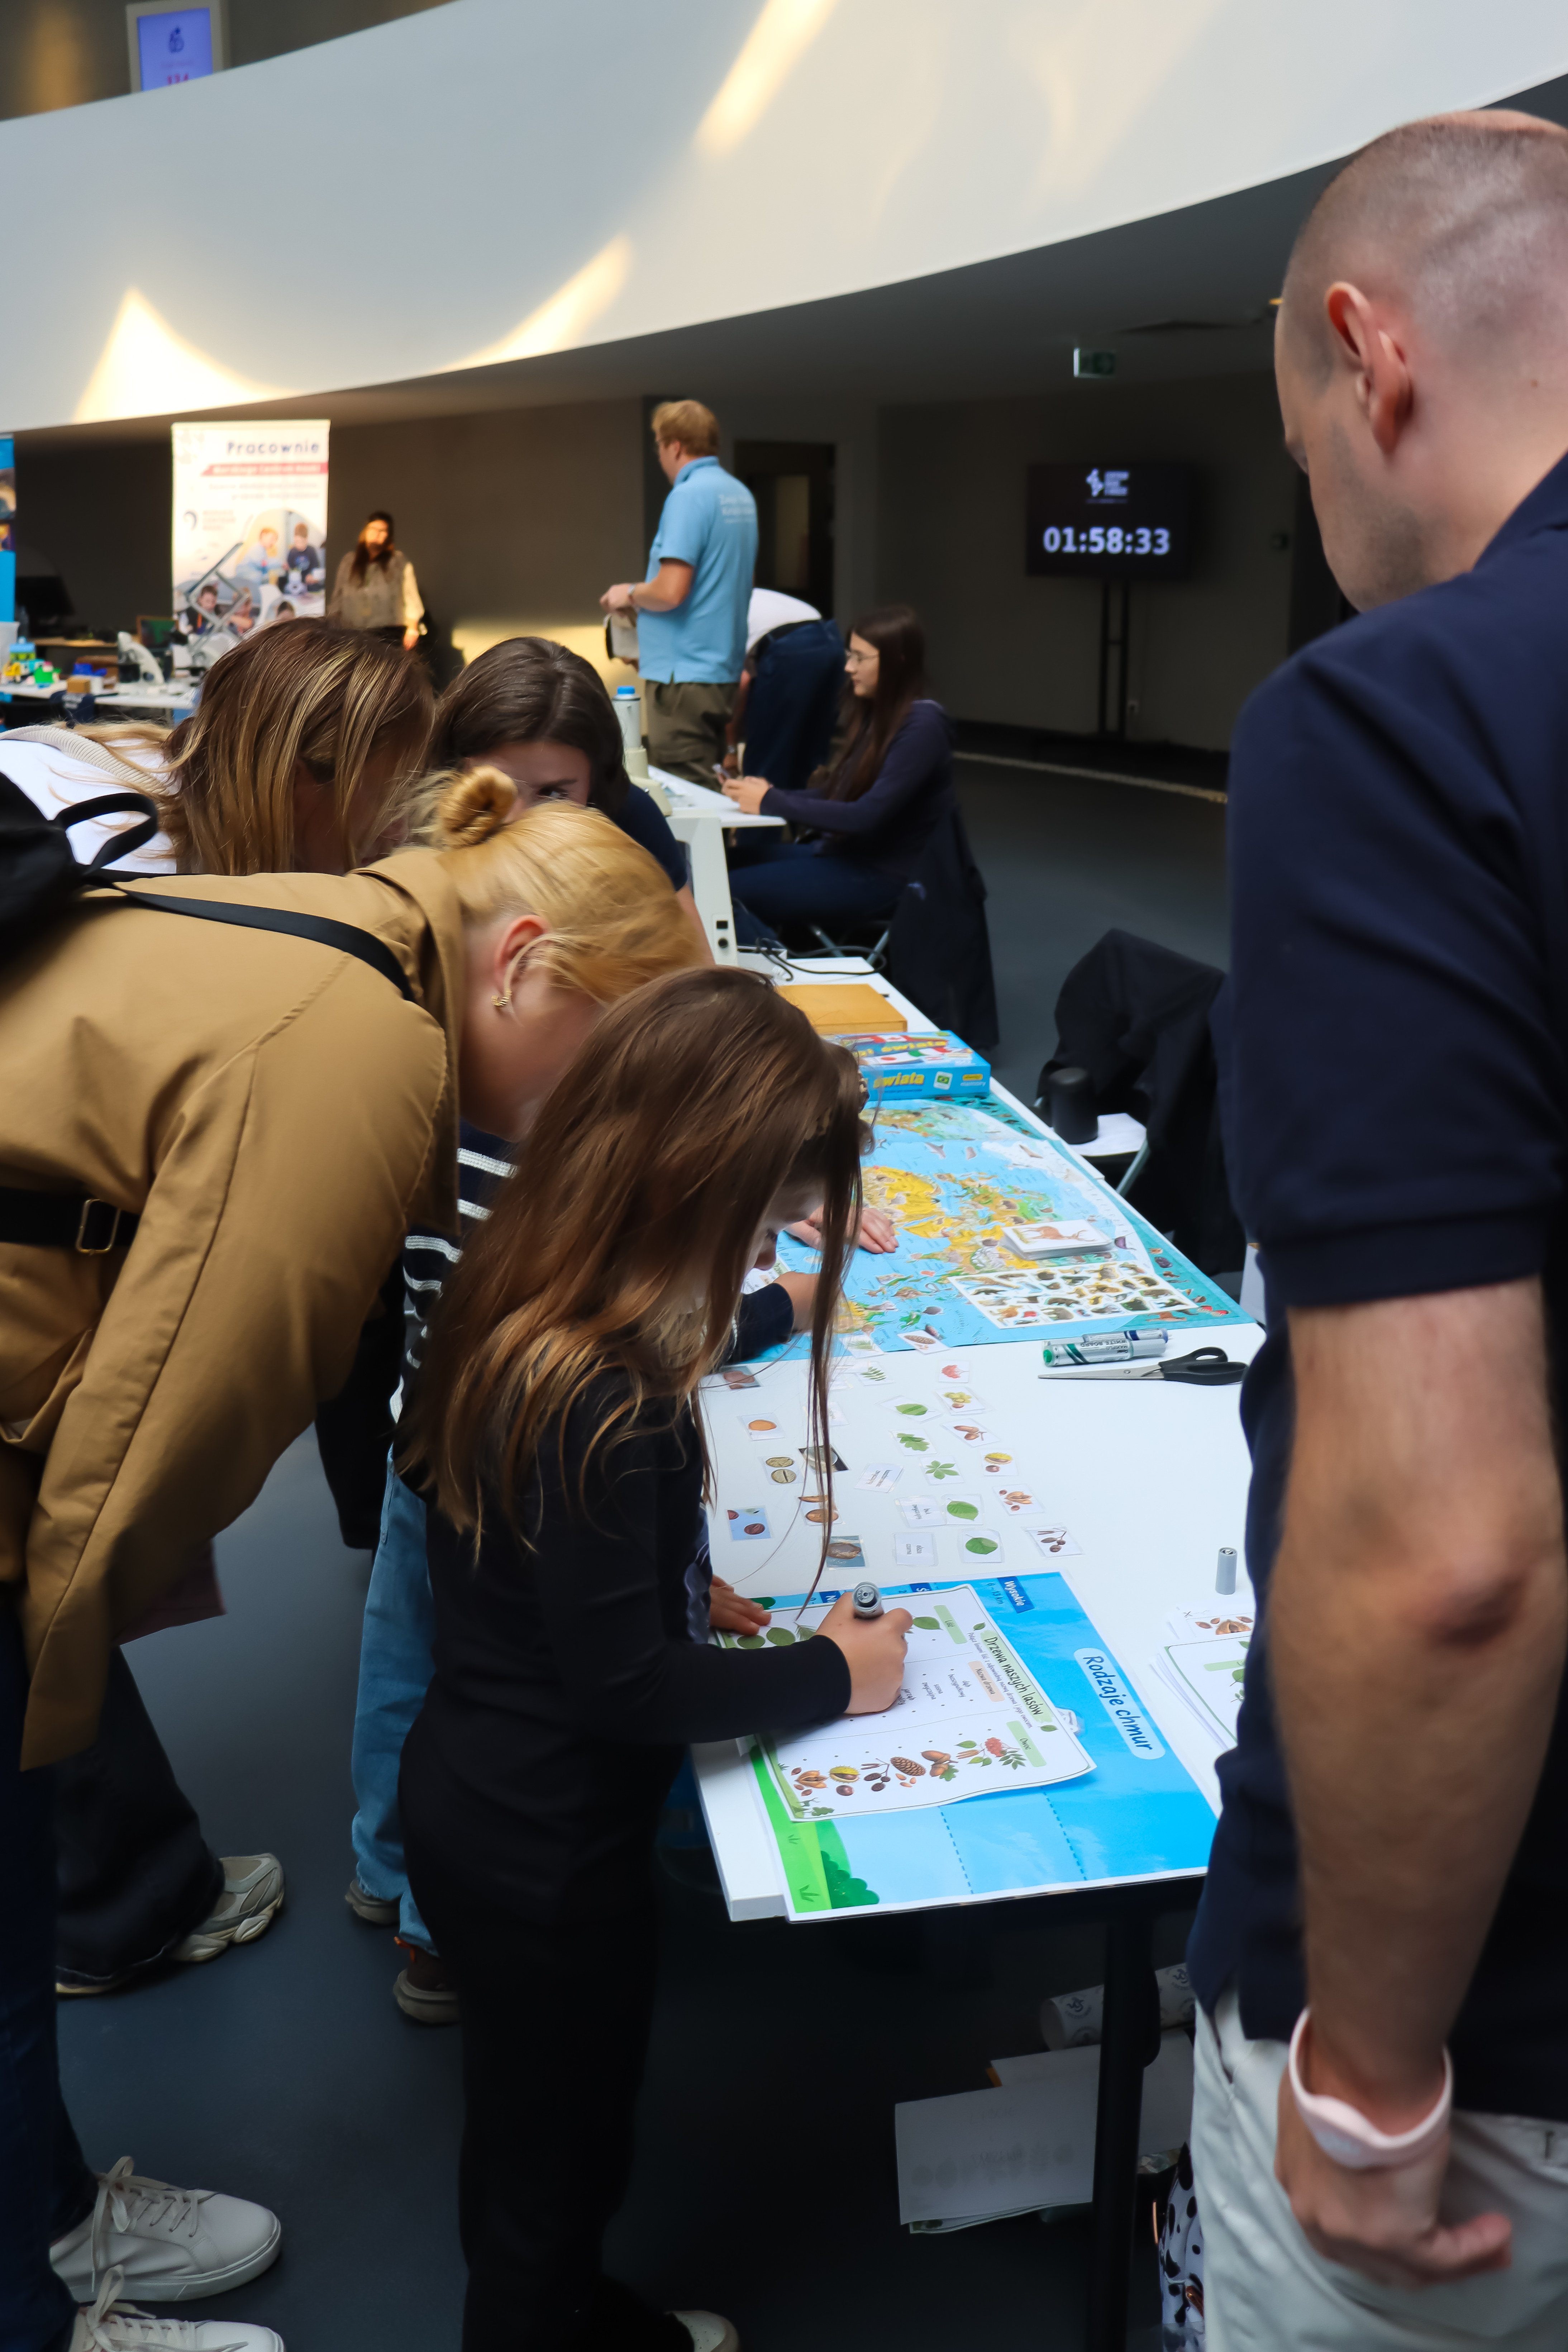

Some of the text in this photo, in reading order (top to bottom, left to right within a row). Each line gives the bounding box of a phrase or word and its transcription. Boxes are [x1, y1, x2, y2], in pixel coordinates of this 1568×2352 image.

[227, 440, 319, 454] Pracownie
[1043, 526, 1170, 555] 01:58:33
[995, 1596, 1004, 1604] km
[1004, 1581, 1026, 1606] Wysokie
[945, 1619, 955, 1628] Liść
[975, 1668, 995, 1694] Nazwa drzewa
[983, 1636, 1043, 1715] Drzewa naszych lasów
[901, 1688, 916, 1701] jarząb
[922, 1681, 936, 1700] zwyczajna
[933, 1683, 943, 1694] sosna
[1006, 1692, 1017, 1704] drzewa
[1083, 1656, 1153, 1750] Rodzaje chmur
[1020, 1738, 1031, 1750] Owoc
